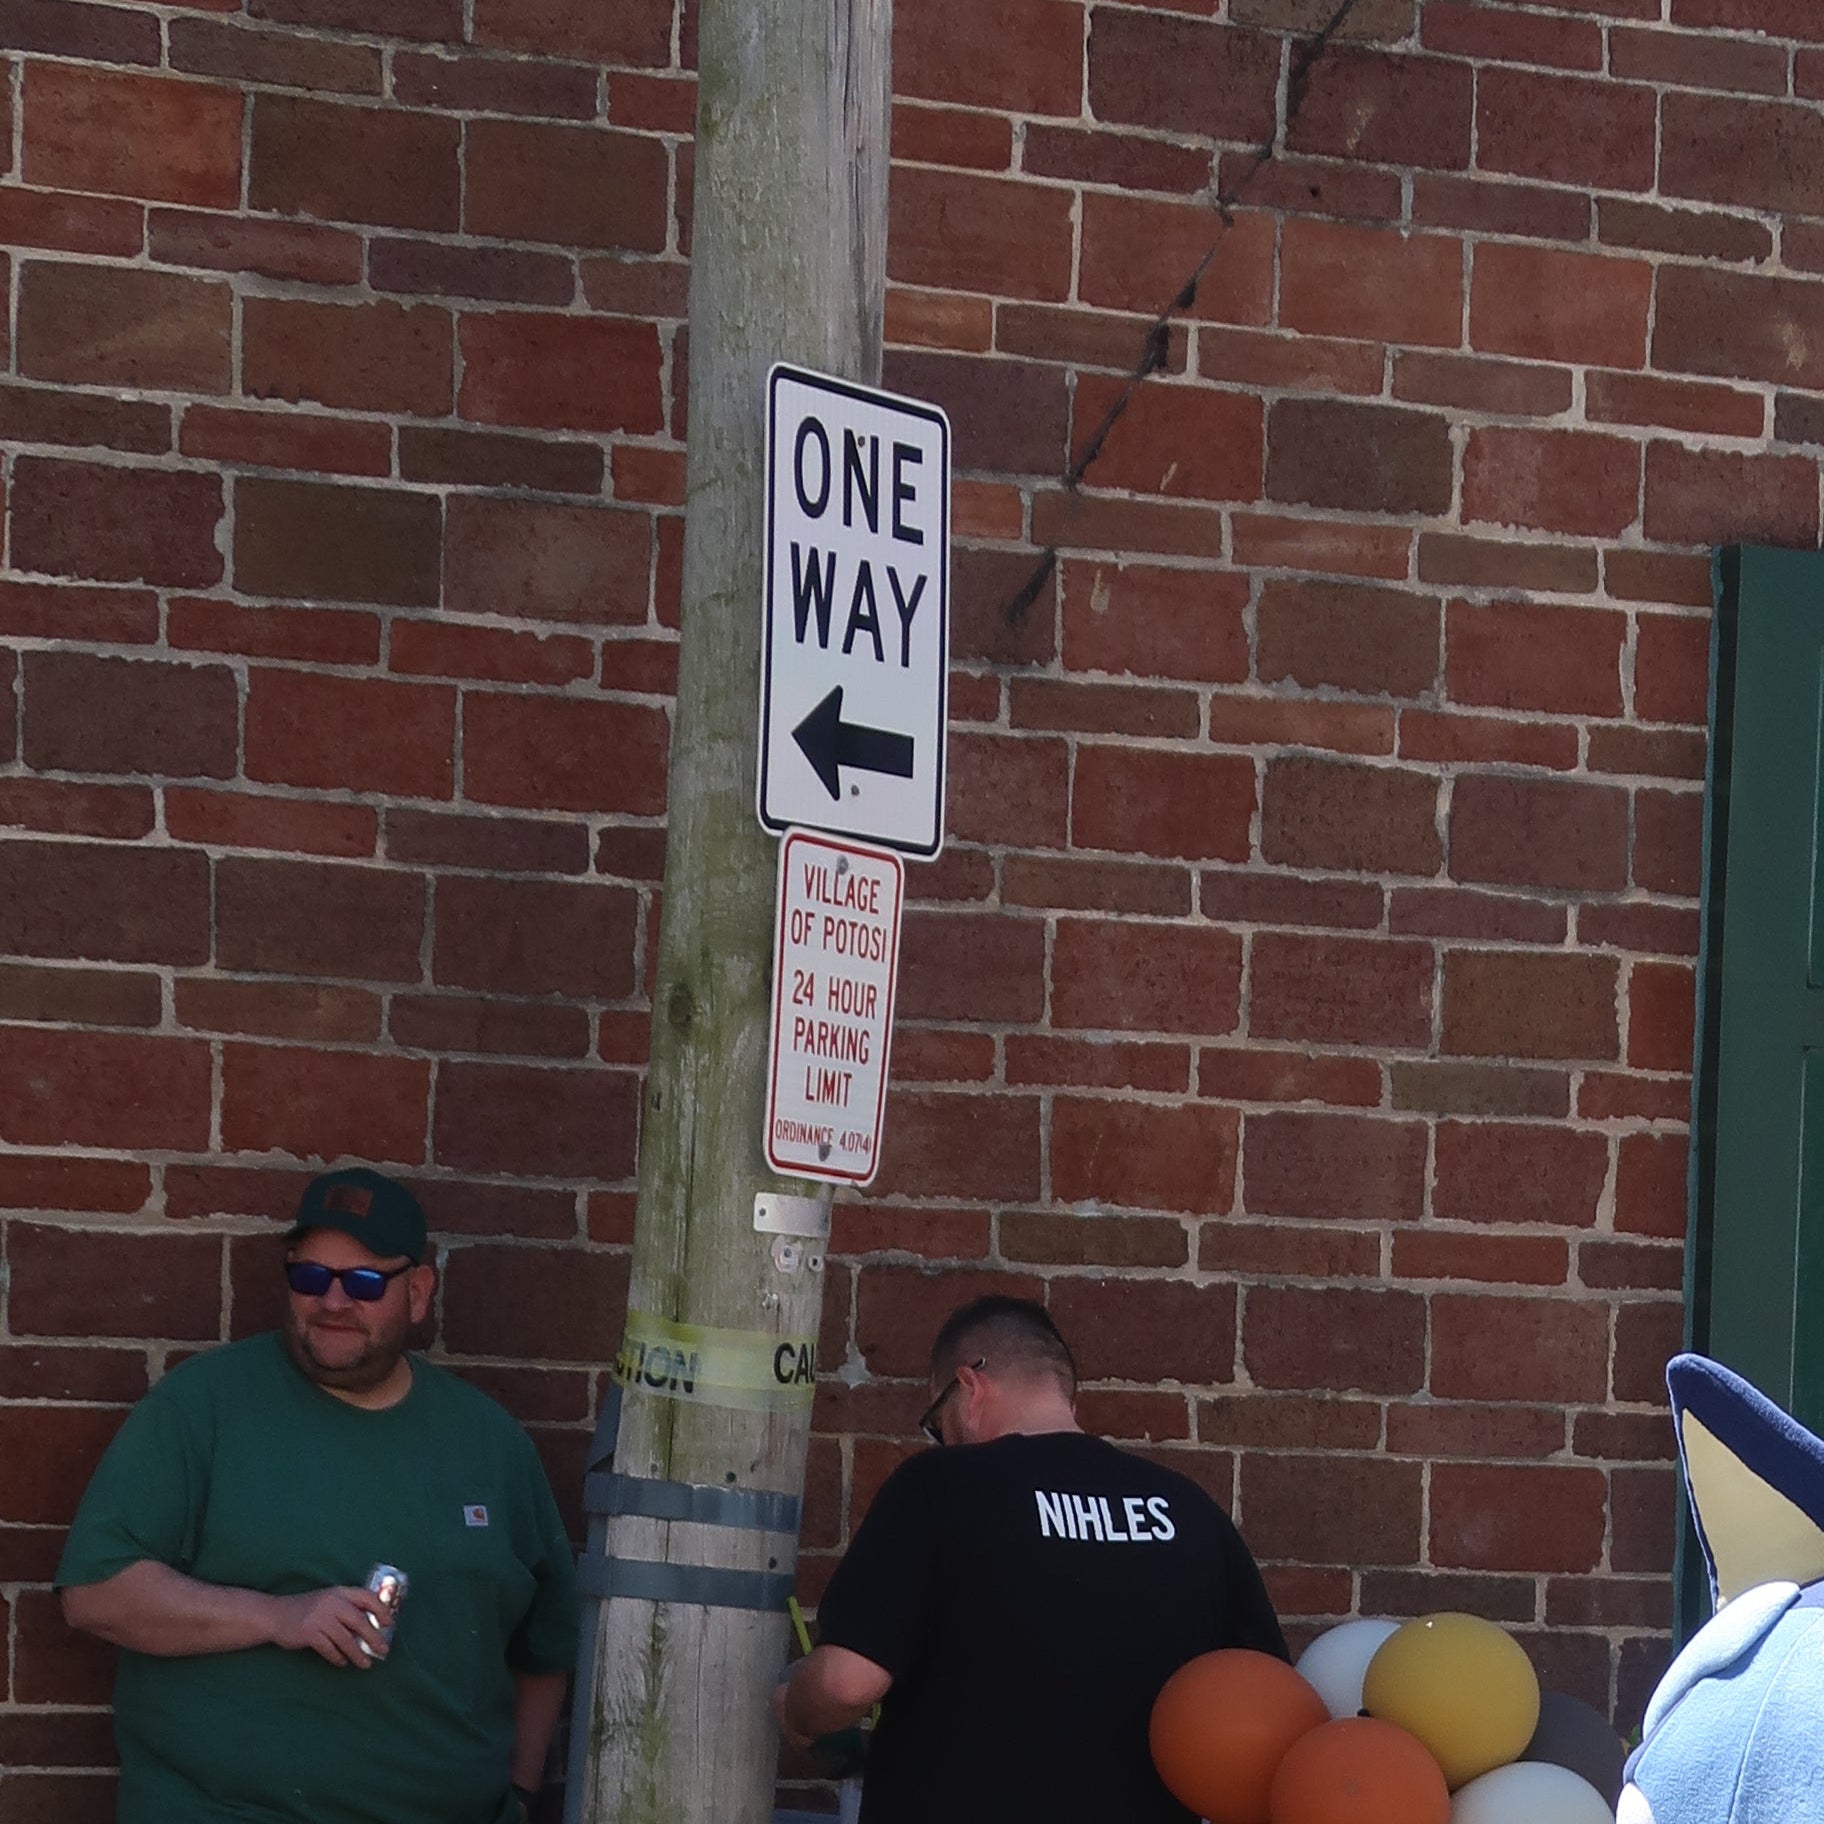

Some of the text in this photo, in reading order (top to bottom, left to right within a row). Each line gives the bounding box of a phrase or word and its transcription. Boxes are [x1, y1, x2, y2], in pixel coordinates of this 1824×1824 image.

[794, 416, 924, 546] ONE
[790, 541, 928, 668] WAY
[804, 863, 881, 915] VILLAGE
[791, 908, 887, 963] OF POTOSI
[792, 969, 877, 1019] 24 HOUR
[793, 1017, 870, 1065] PARKING
[805, 1065, 852, 1108] LIMIT
[775, 1118, 834, 1148] ORDINANCE
[1035, 1490, 1176, 1541] NIHLES
